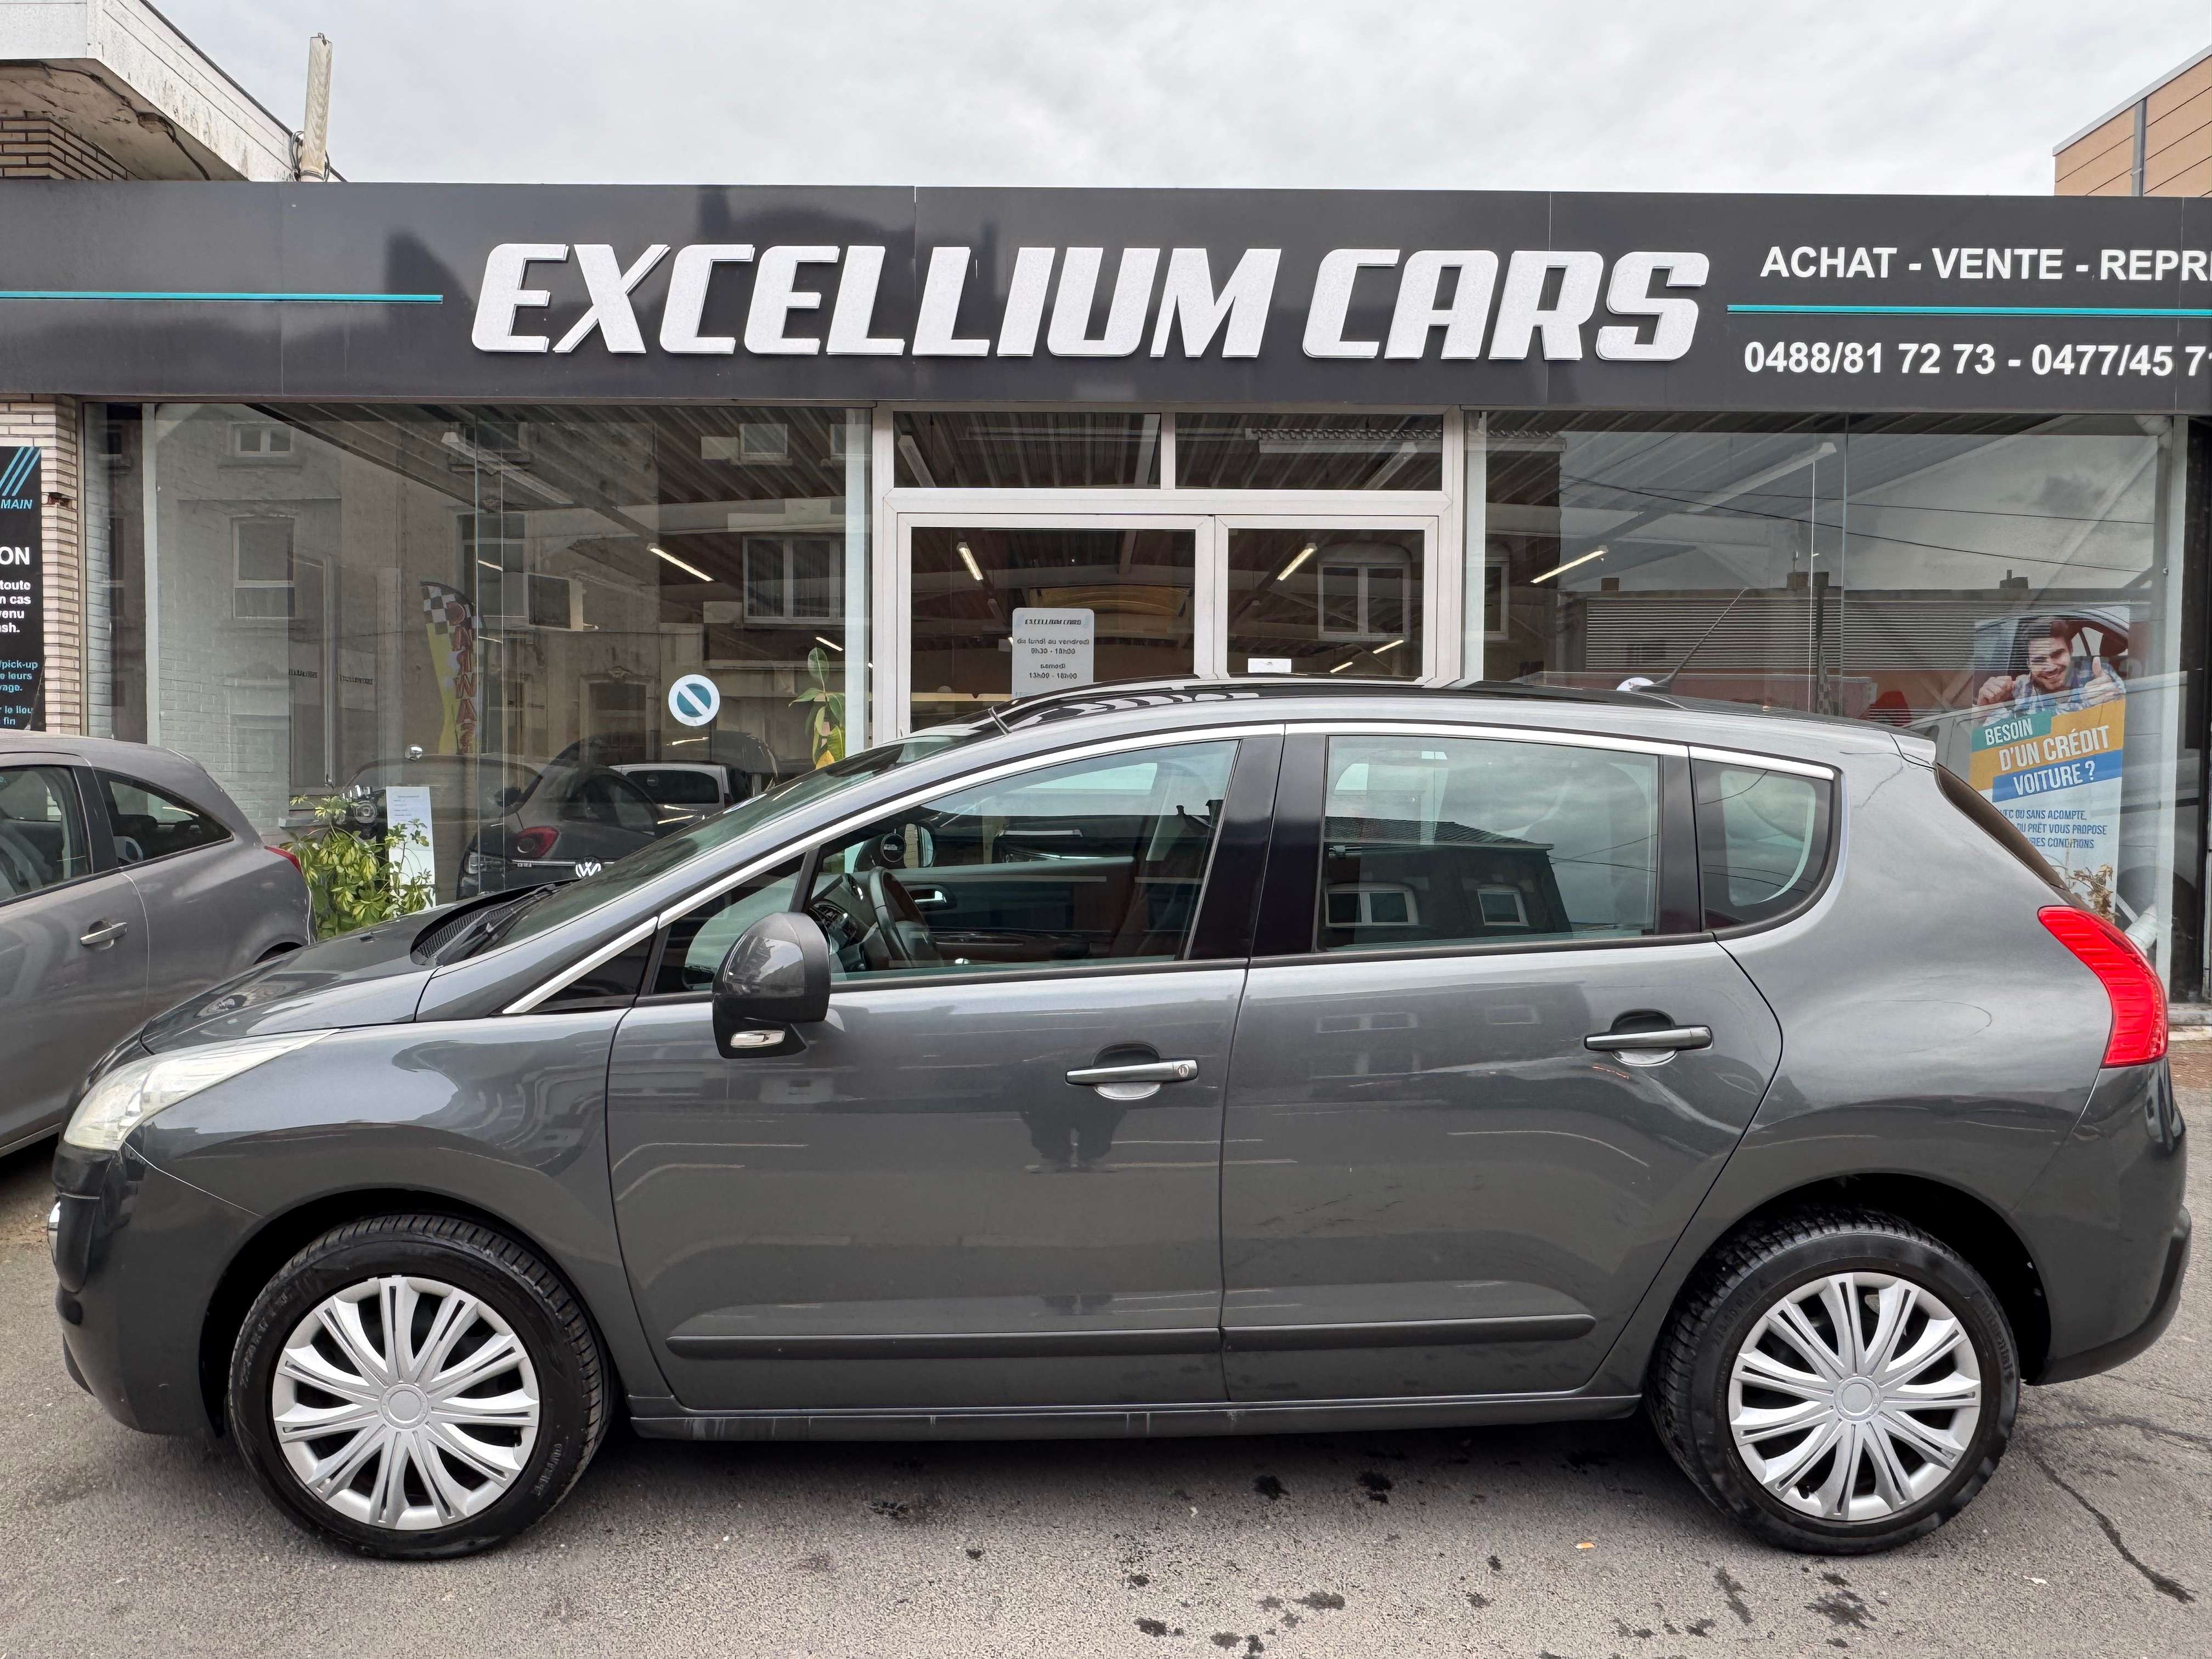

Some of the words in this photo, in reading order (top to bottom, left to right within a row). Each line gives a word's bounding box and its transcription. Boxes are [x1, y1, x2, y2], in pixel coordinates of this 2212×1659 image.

[1760, 246, 1898, 279] ACHAT
[1932, 247, 2063, 280] VENTE
[2100, 249, 2212, 281] REPR
[472, 243, 1282, 358] EXCELLIUM
[1302, 247, 1710, 361] CARS
[1745, 341, 1882, 374] 0488/81
[1898, 343, 1940, 374] 72
[1953, 343, 1995, 375] 73
[2032, 344, 2173, 377] 0477/45
[2185, 346, 2212, 377] 7
[1, 499, 33, 509] MAIN
[9, 596, 31, 605] cas
[1985, 718, 2033, 746] BESOIN
[1999, 742, 2040, 771] D'UN
[2042, 725, 2109, 761] CRÉDIT
[2013, 763, 2083, 795] VOITURE
[2085, 760, 2095, 781] ?
[2027, 810, 2046, 820] SANS
[2048, 838, 2095, 849] CONDITIONS
[2049, 824, 2070, 834] VOUS
[2072, 825, 2108, 836] PROPOSE
